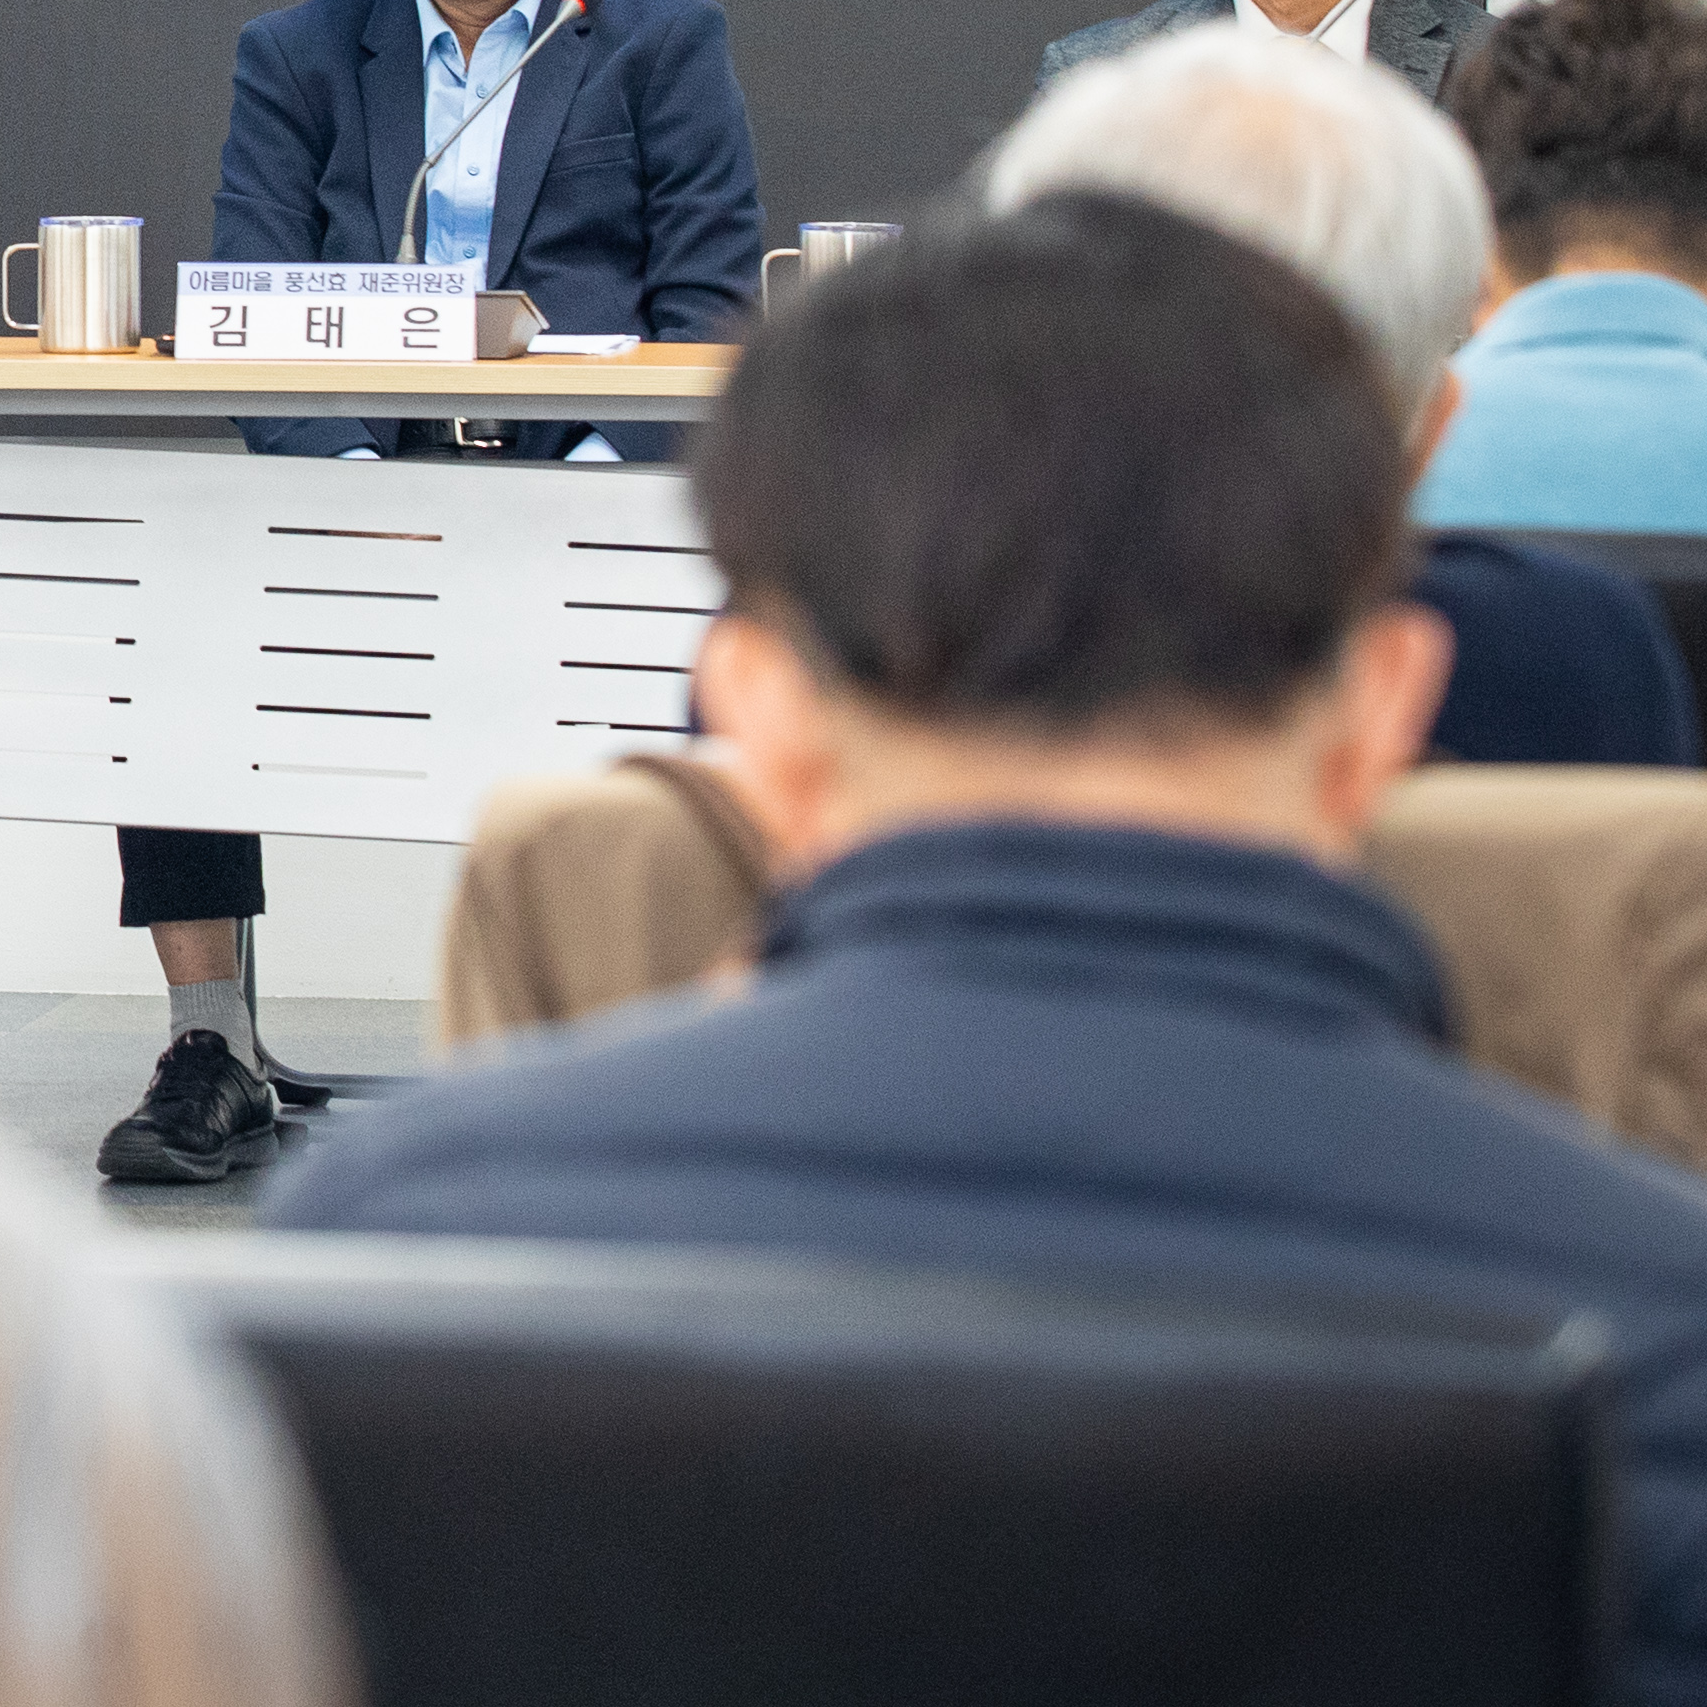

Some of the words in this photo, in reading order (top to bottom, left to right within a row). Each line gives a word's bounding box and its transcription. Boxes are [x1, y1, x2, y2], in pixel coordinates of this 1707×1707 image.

[189, 270, 273, 292] 아름마을
[285, 271, 346, 293] 풍선효
[358, 272, 466, 294] 재준위원장
